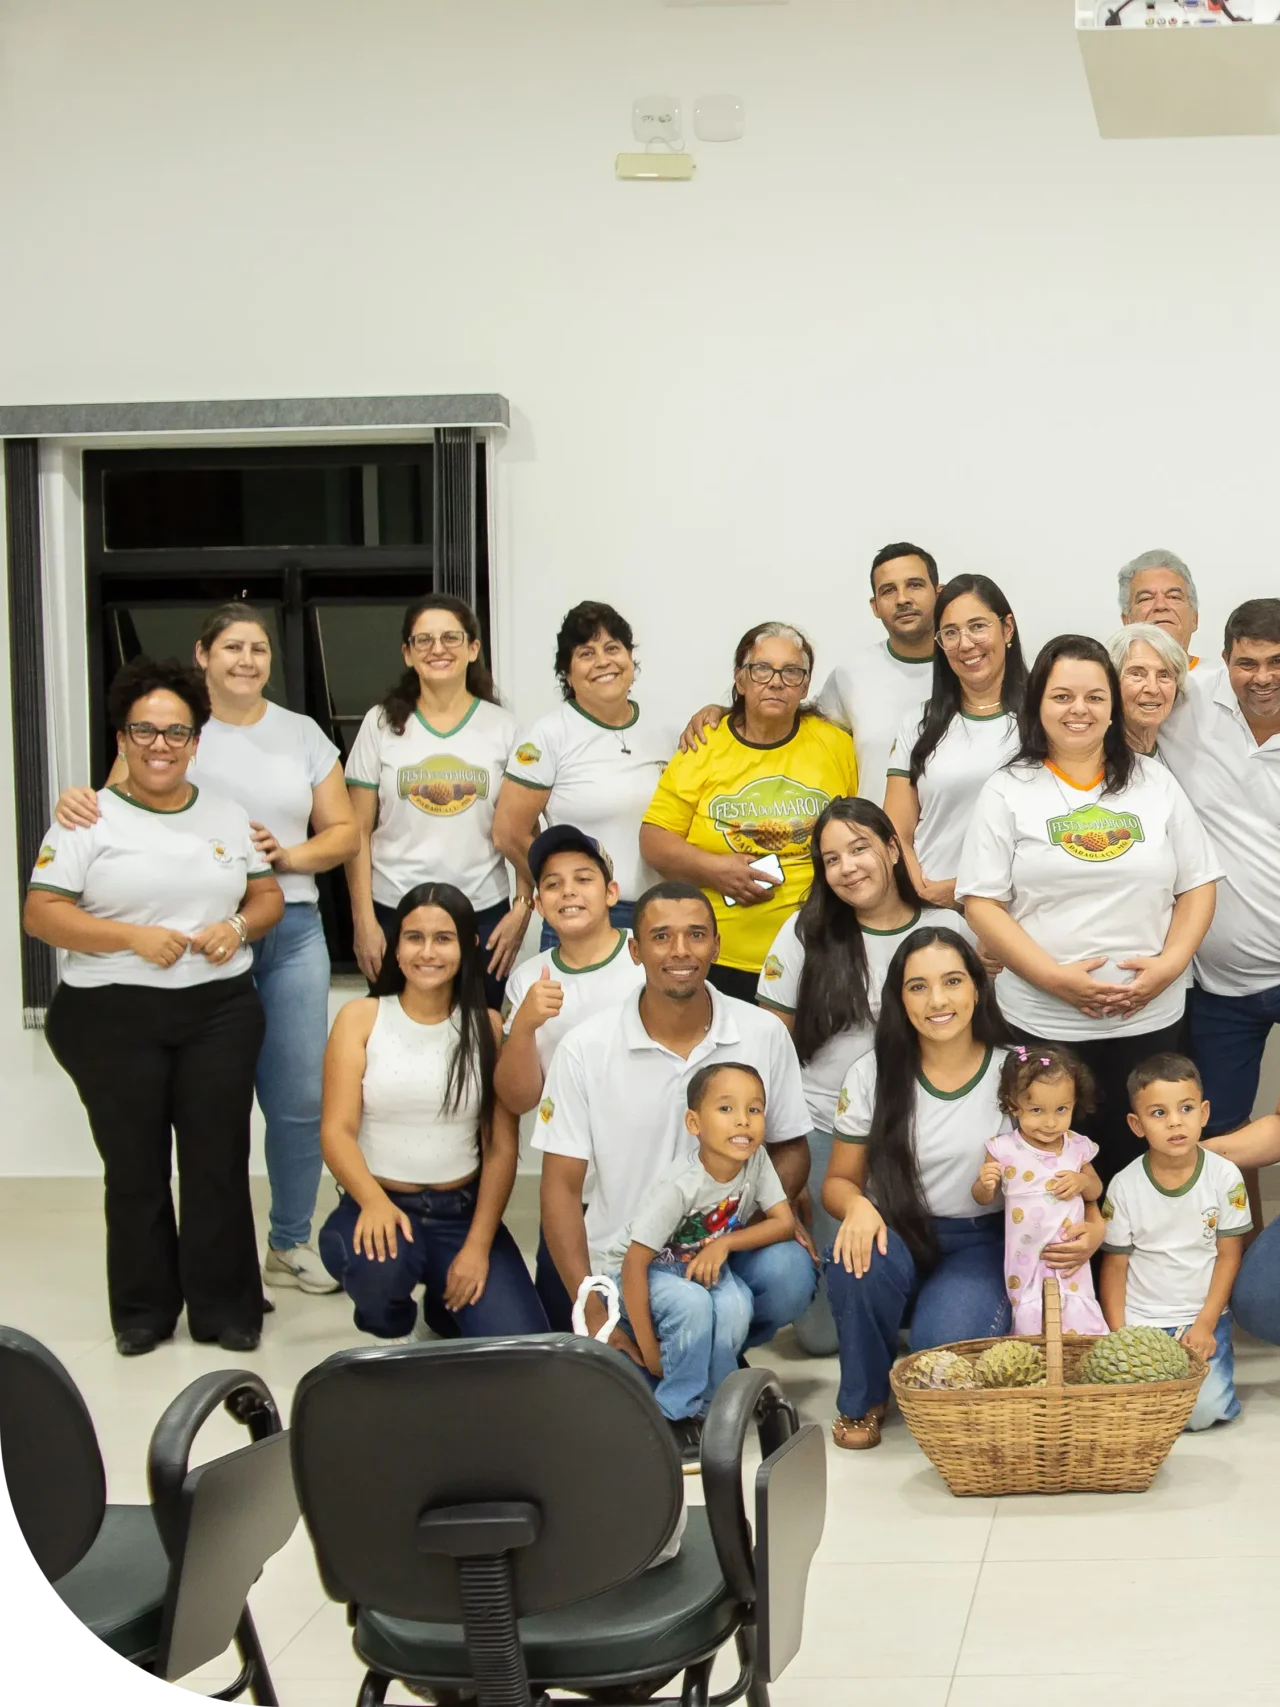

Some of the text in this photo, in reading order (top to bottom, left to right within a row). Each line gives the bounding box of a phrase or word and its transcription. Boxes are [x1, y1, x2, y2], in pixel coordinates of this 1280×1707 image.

[715, 801, 758, 819] FESTA
[1052, 820, 1083, 832] FESTA
[1093, 816, 1138, 830] MAROLO
[1069, 844, 1116, 858] PARAGUAÇU
